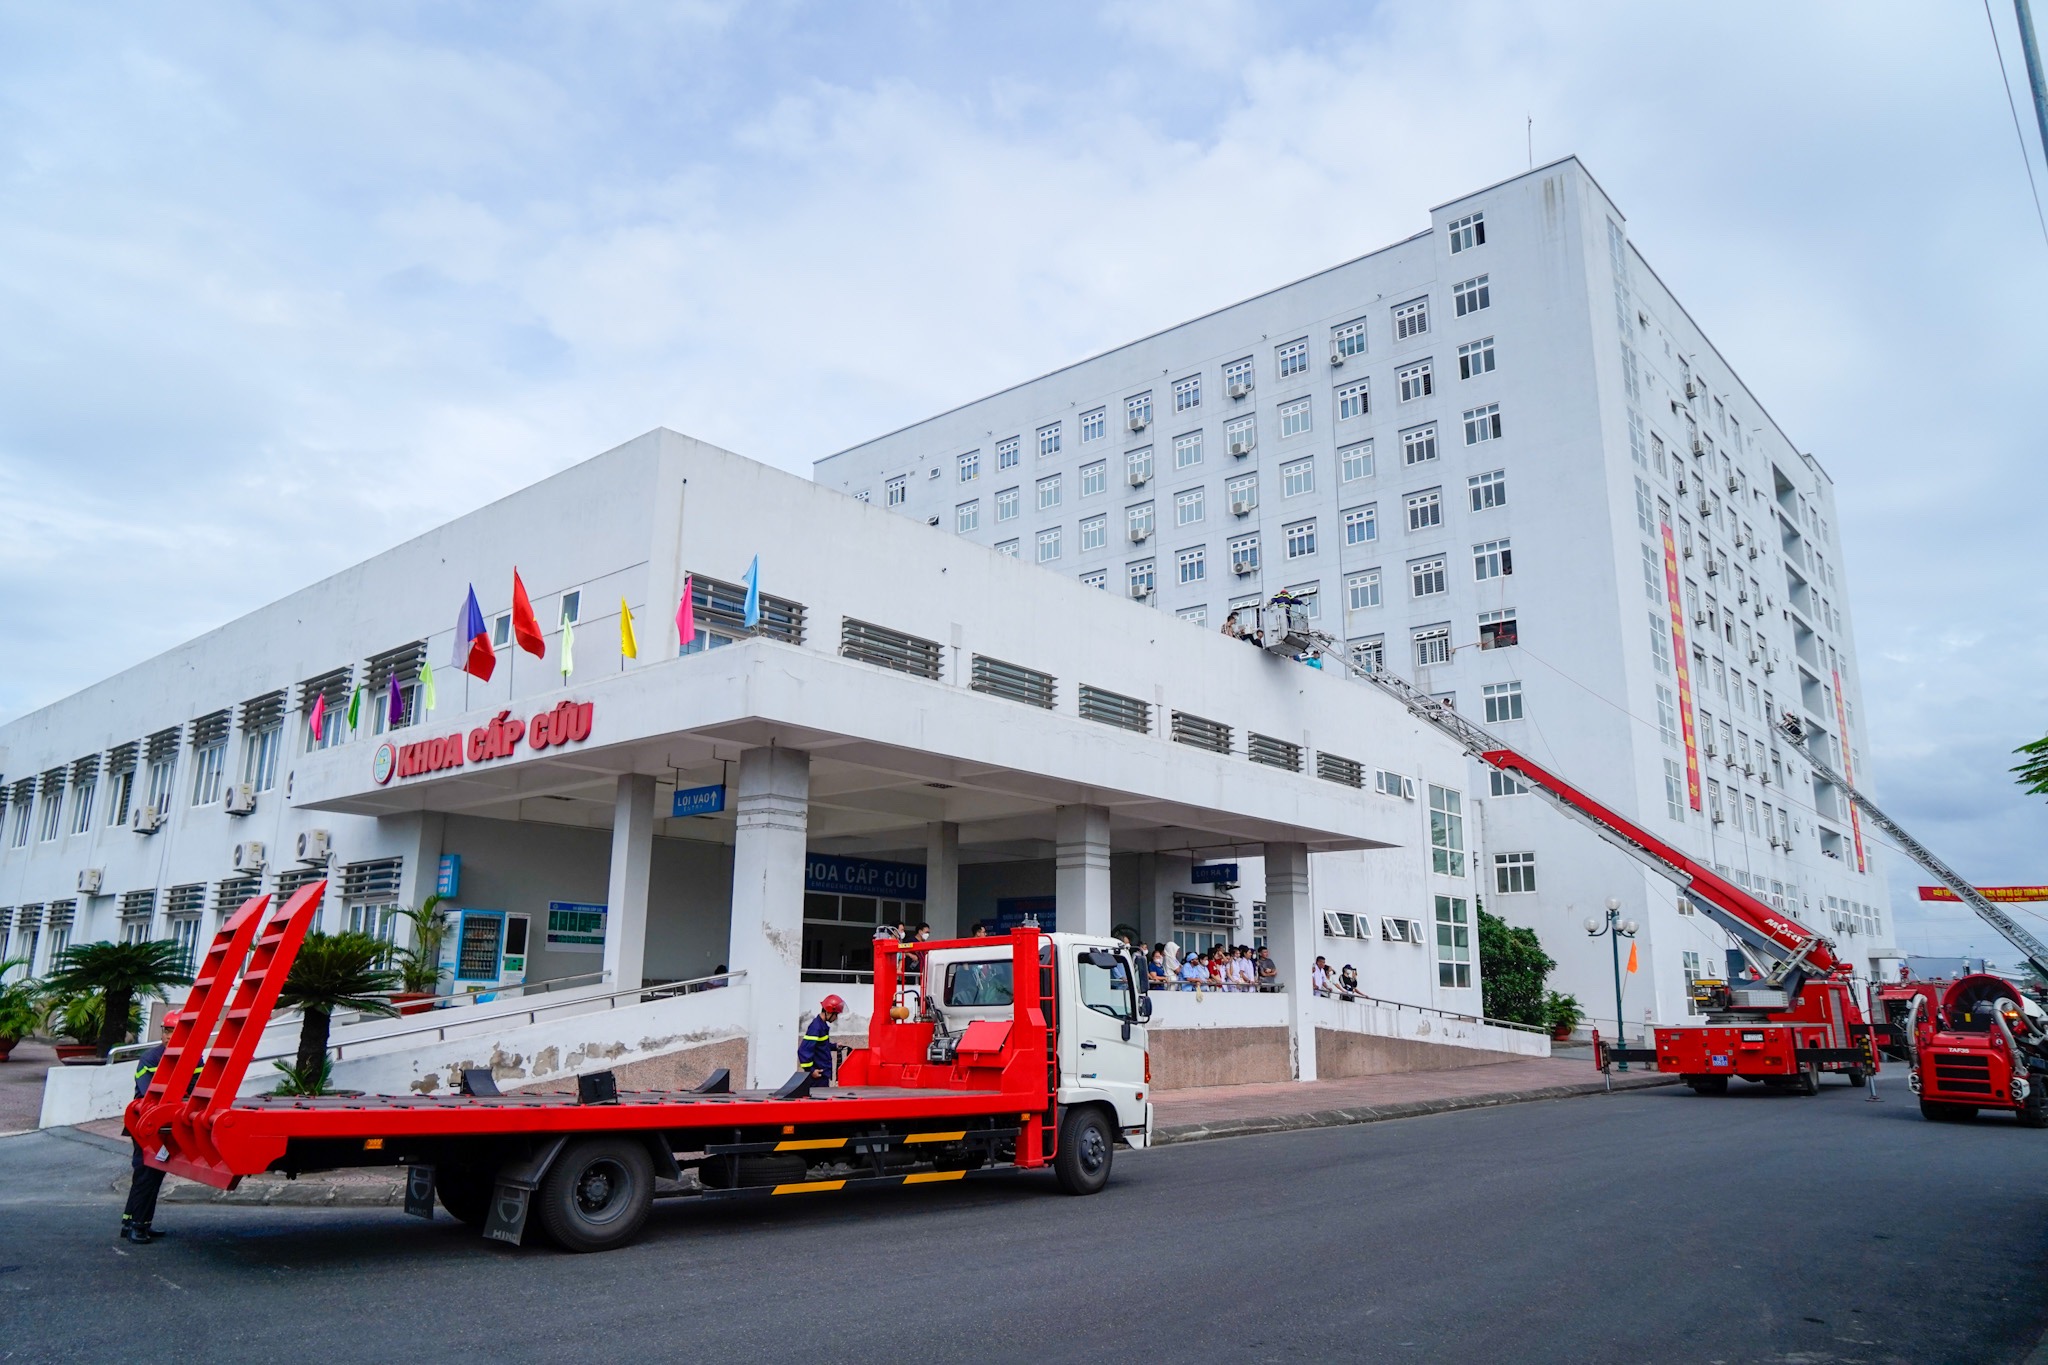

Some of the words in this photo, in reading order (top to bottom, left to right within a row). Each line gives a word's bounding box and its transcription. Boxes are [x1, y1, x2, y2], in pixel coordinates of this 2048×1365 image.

[398, 733, 464, 777] KHOA
[467, 710, 527, 762] CẤP
[529, 700, 594, 750] CỨU
[805, 862, 839, 881] HOA
[845, 862, 879, 885] CẤP
[884, 868, 919, 890] CỨU
[811, 880, 853, 891] EMERGENCY
[854, 884, 897, 895] DEPARTMENT
[408, 1205, 428, 1217] HINO
[492, 1229, 518, 1242] HINO
